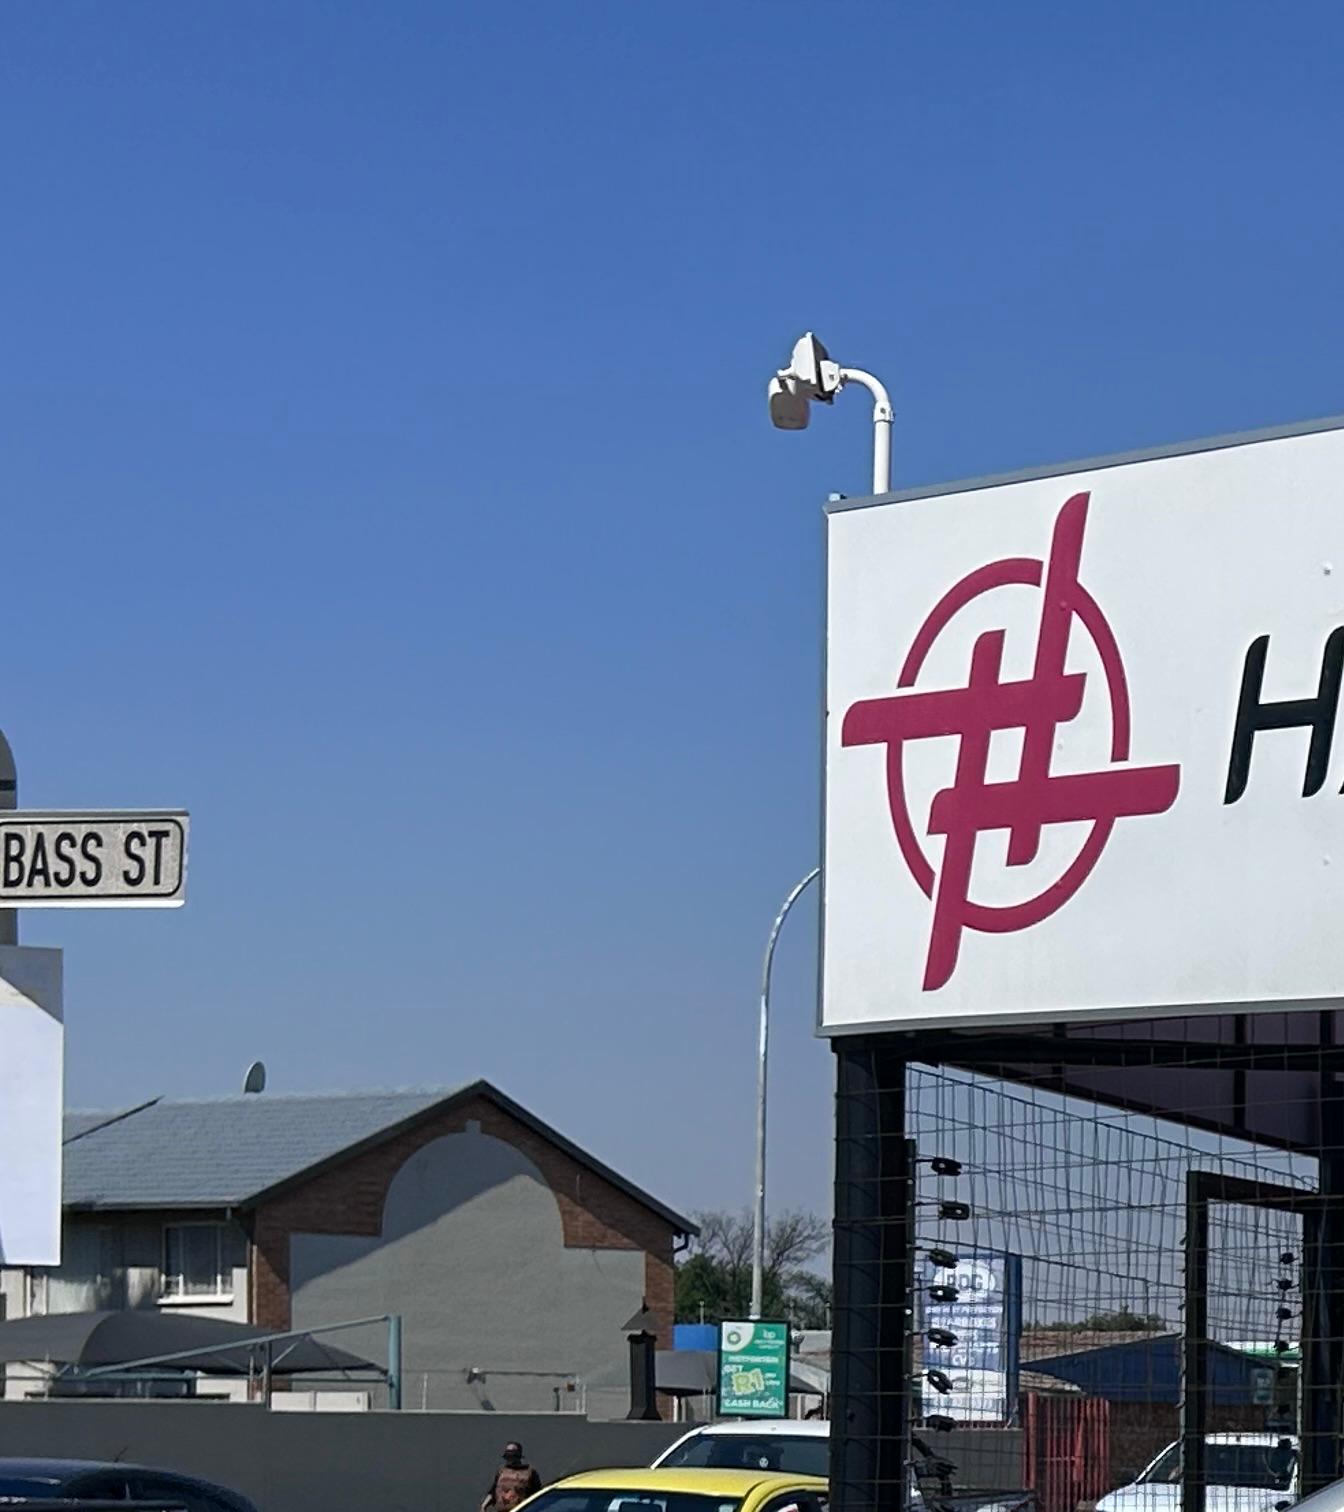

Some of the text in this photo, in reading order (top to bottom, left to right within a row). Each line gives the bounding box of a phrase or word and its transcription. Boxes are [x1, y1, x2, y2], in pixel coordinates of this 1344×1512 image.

[3, 830, 171, 888] BASS ST
[724, 1399, 751, 1408] CASH
